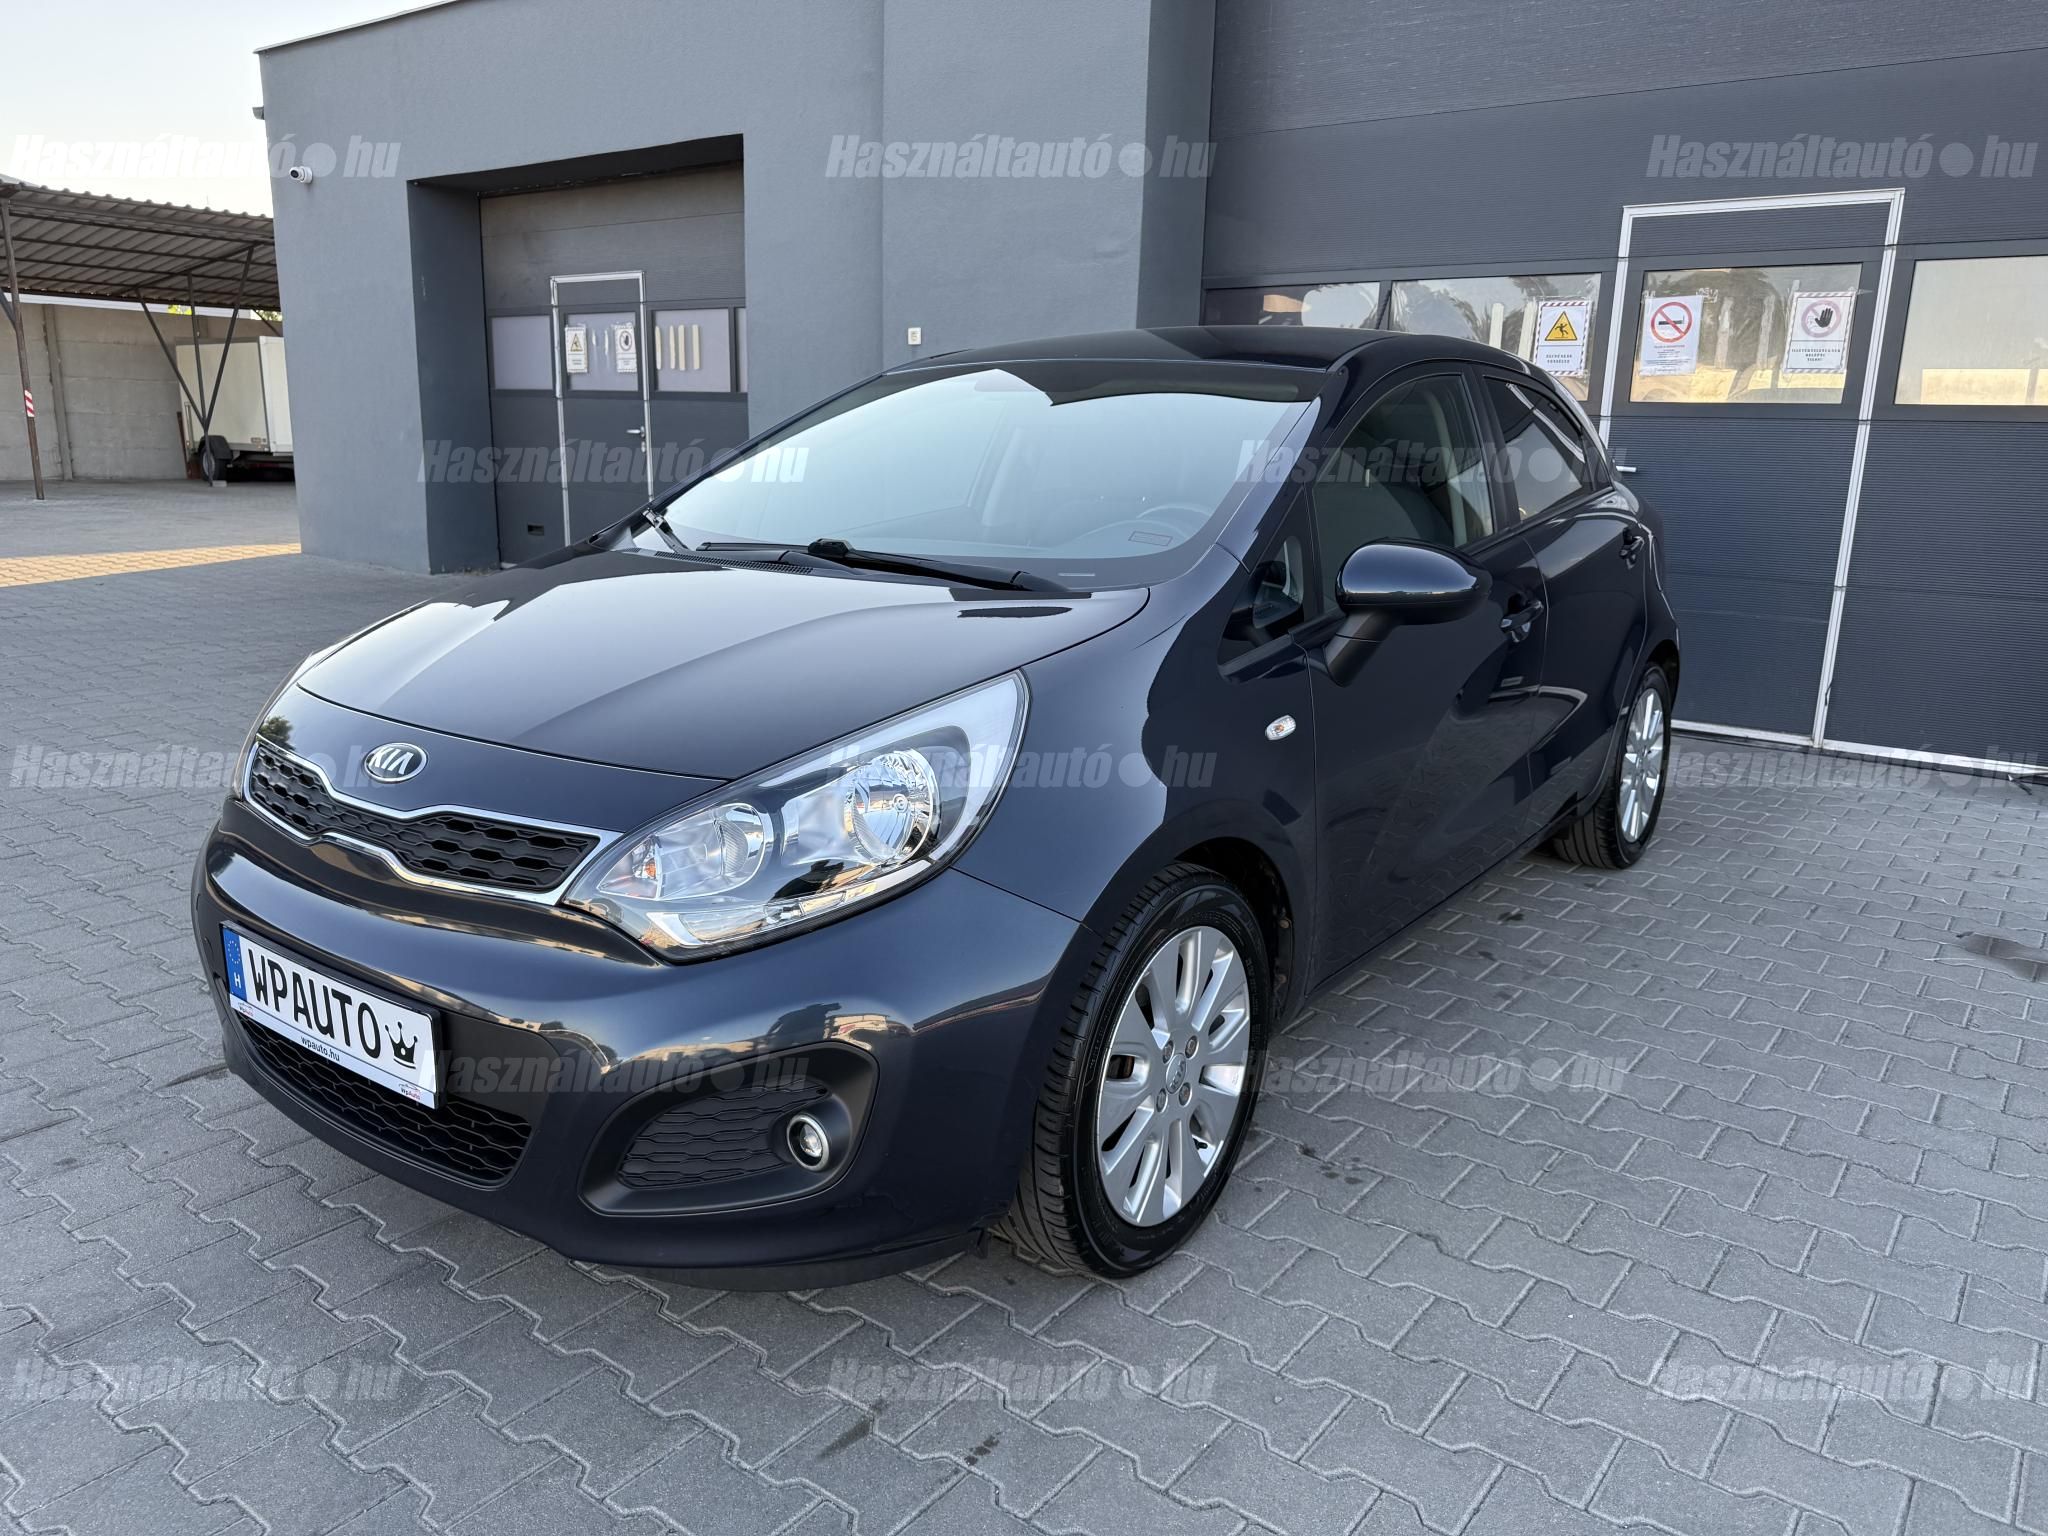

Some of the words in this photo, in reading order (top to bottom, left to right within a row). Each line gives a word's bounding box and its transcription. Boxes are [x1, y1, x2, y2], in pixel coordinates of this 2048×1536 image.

[367, 745, 416, 776] KIA
[233, 972, 242, 989] H
[247, 947, 381, 1059] WPAUTO
[300, 1035, 340, 1062] wpauto.hu
